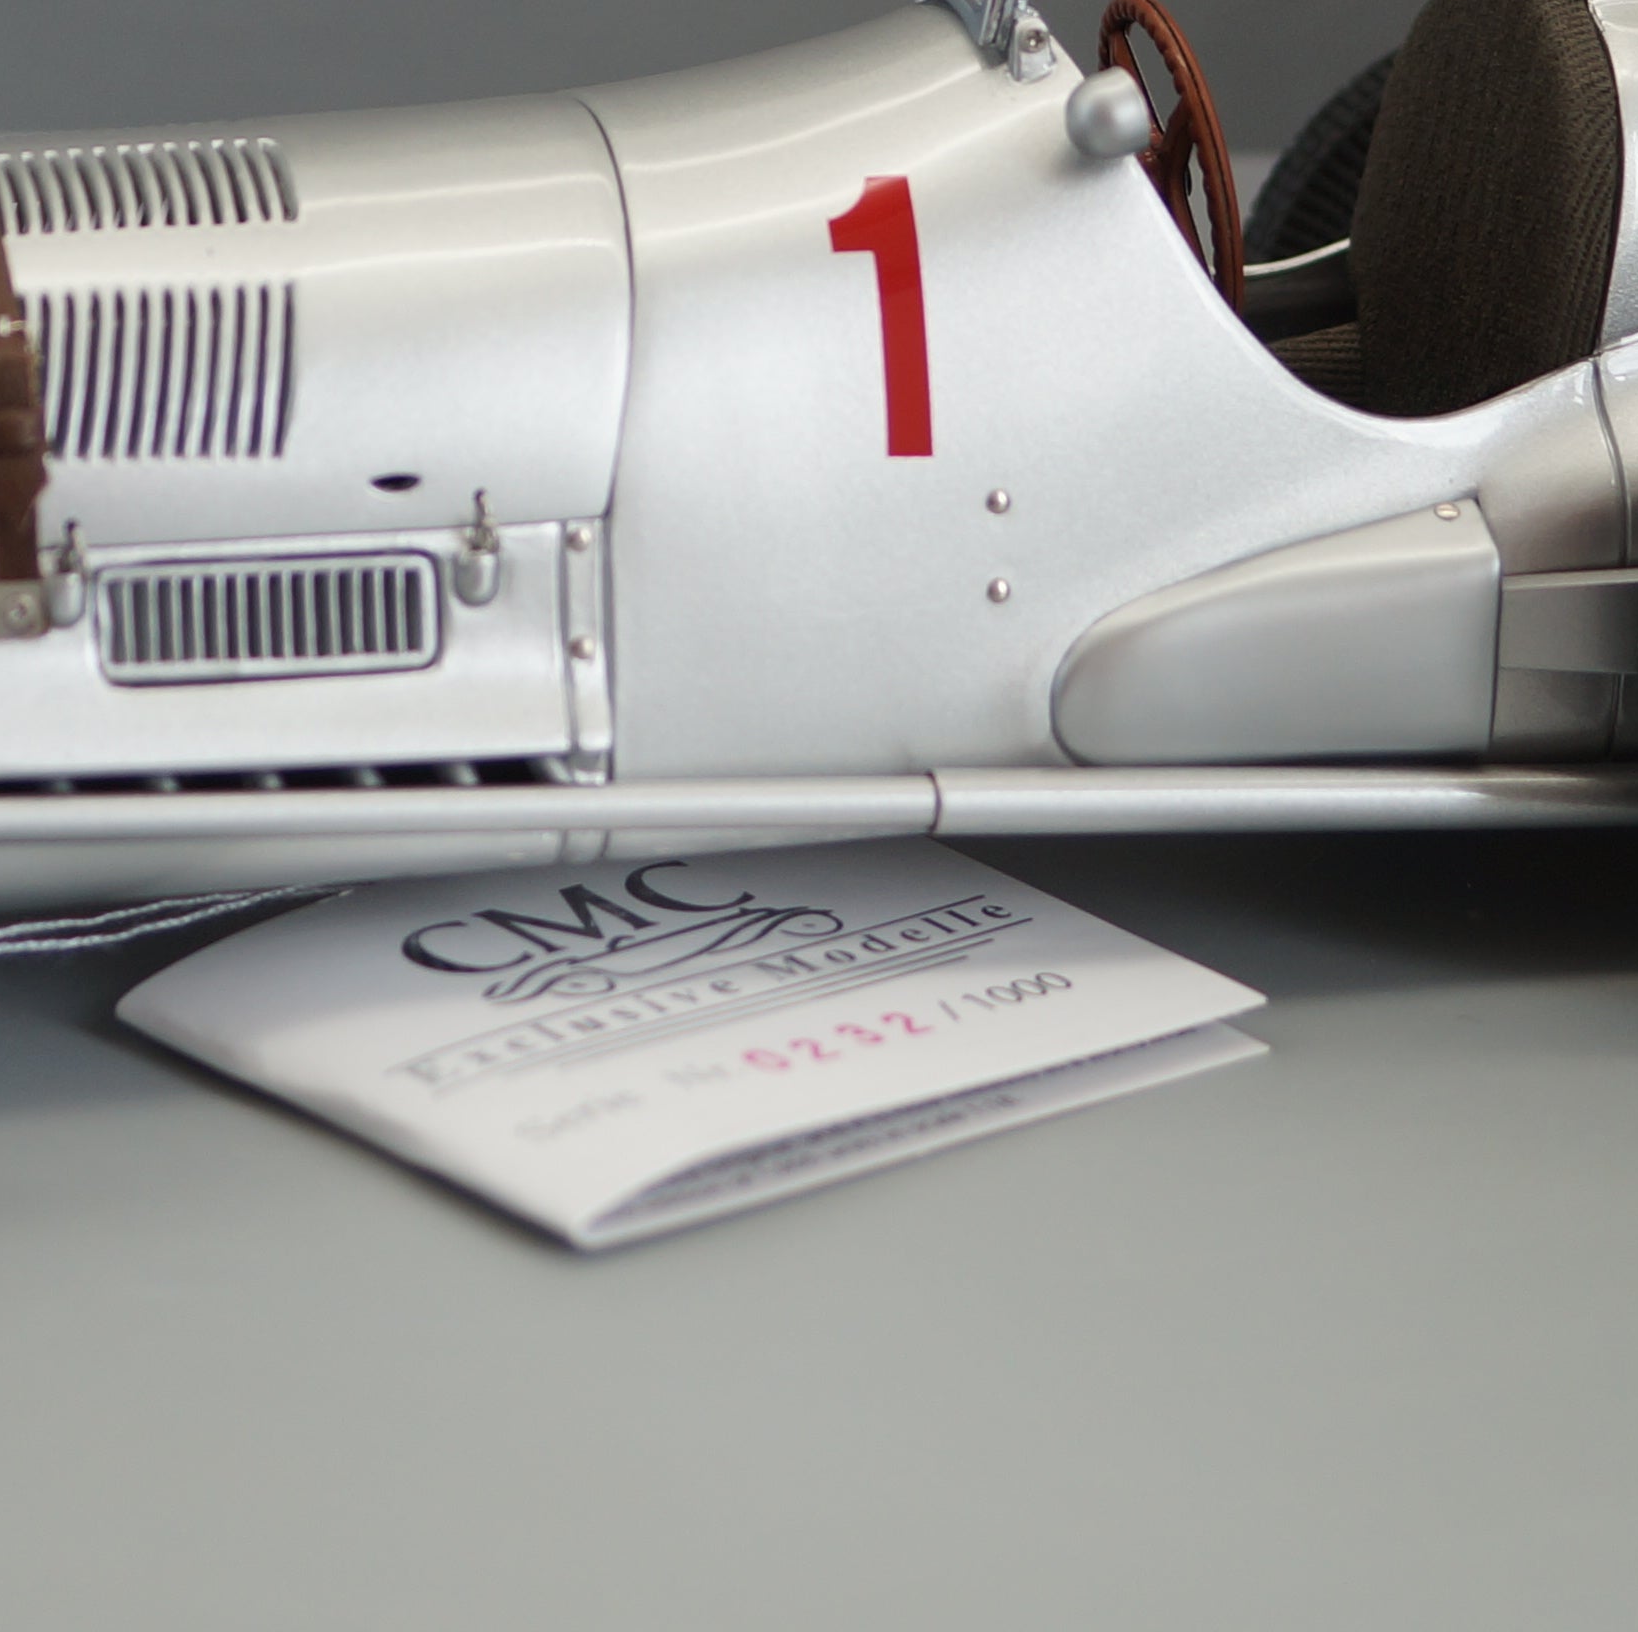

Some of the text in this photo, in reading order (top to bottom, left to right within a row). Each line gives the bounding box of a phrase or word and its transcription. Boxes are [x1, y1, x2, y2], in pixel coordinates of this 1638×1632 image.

[828, 176, 934, 457] 1
[401, 858, 757, 974] CMC
[407, 903, 1013, 1084] Exclusive Modelle
